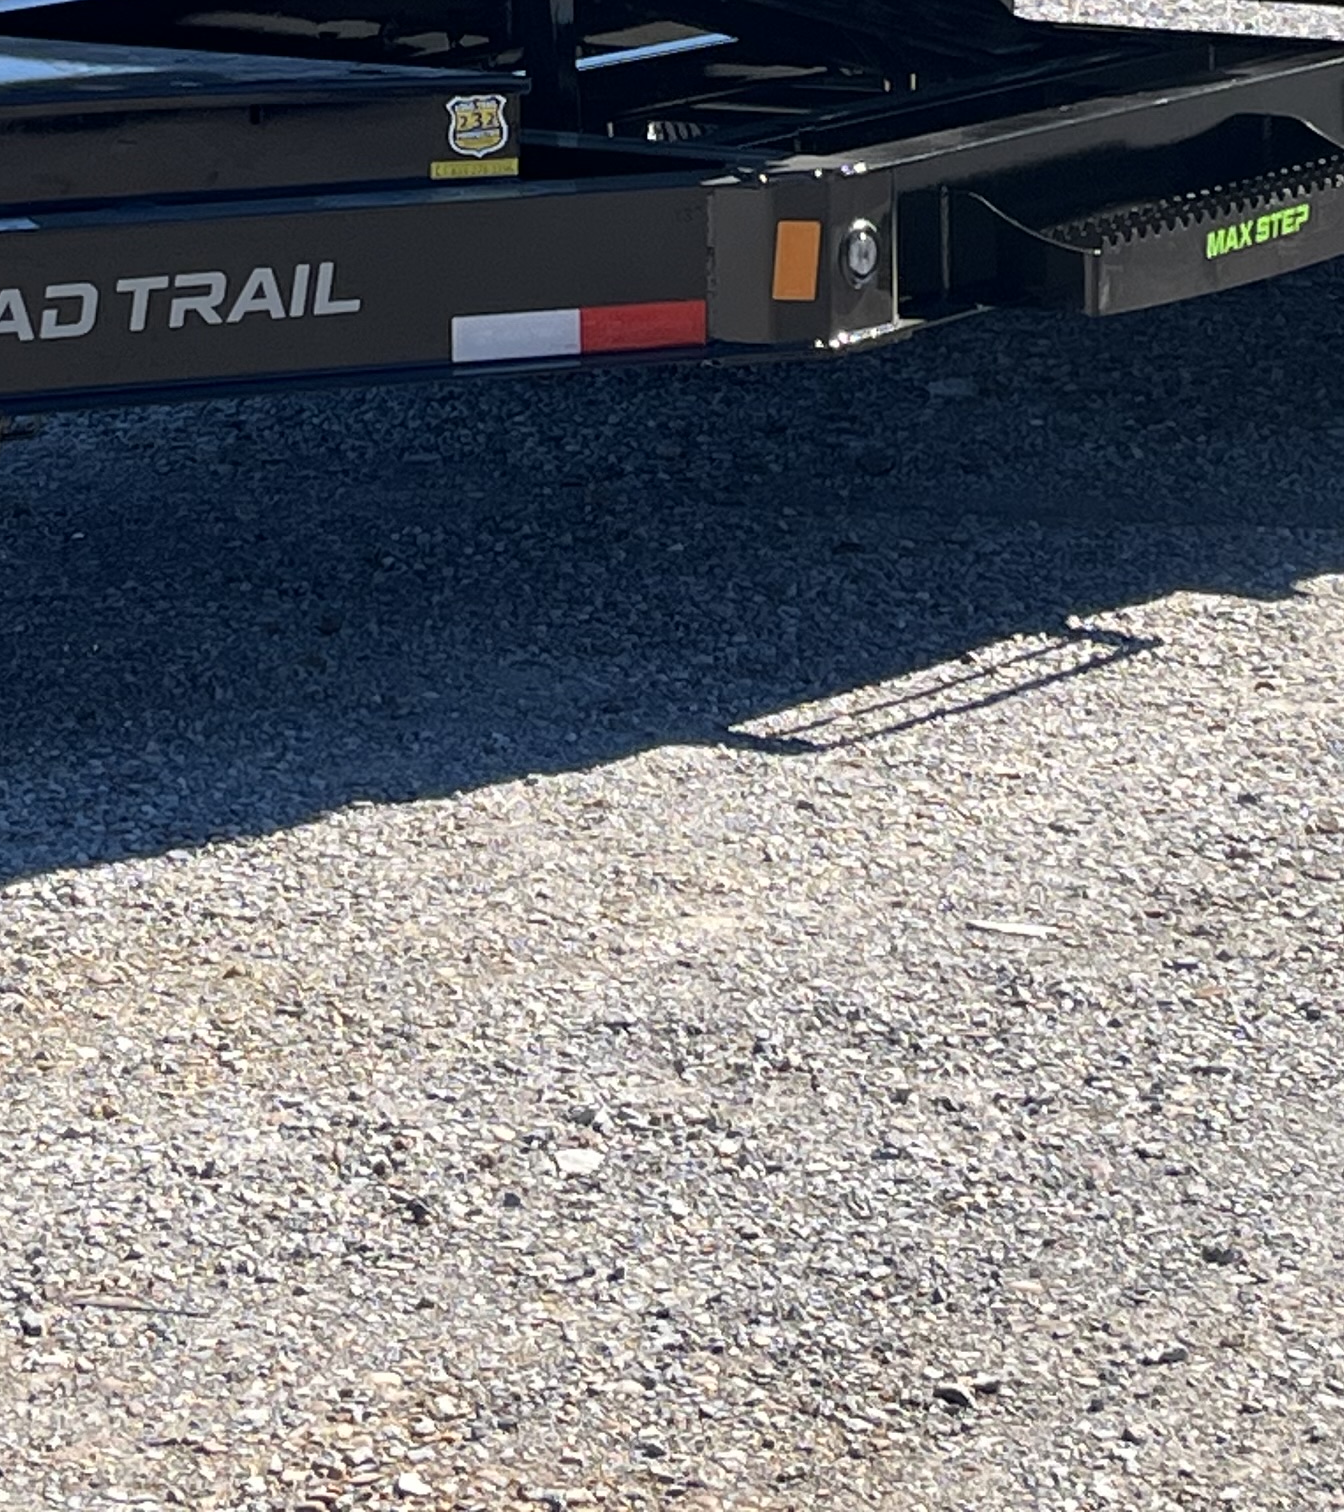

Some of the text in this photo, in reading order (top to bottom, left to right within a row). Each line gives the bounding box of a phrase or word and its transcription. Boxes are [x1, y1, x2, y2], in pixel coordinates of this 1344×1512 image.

[1206, 203, 1310, 259] MAX STEP
[116, 261, 361, 332] TRAIL
